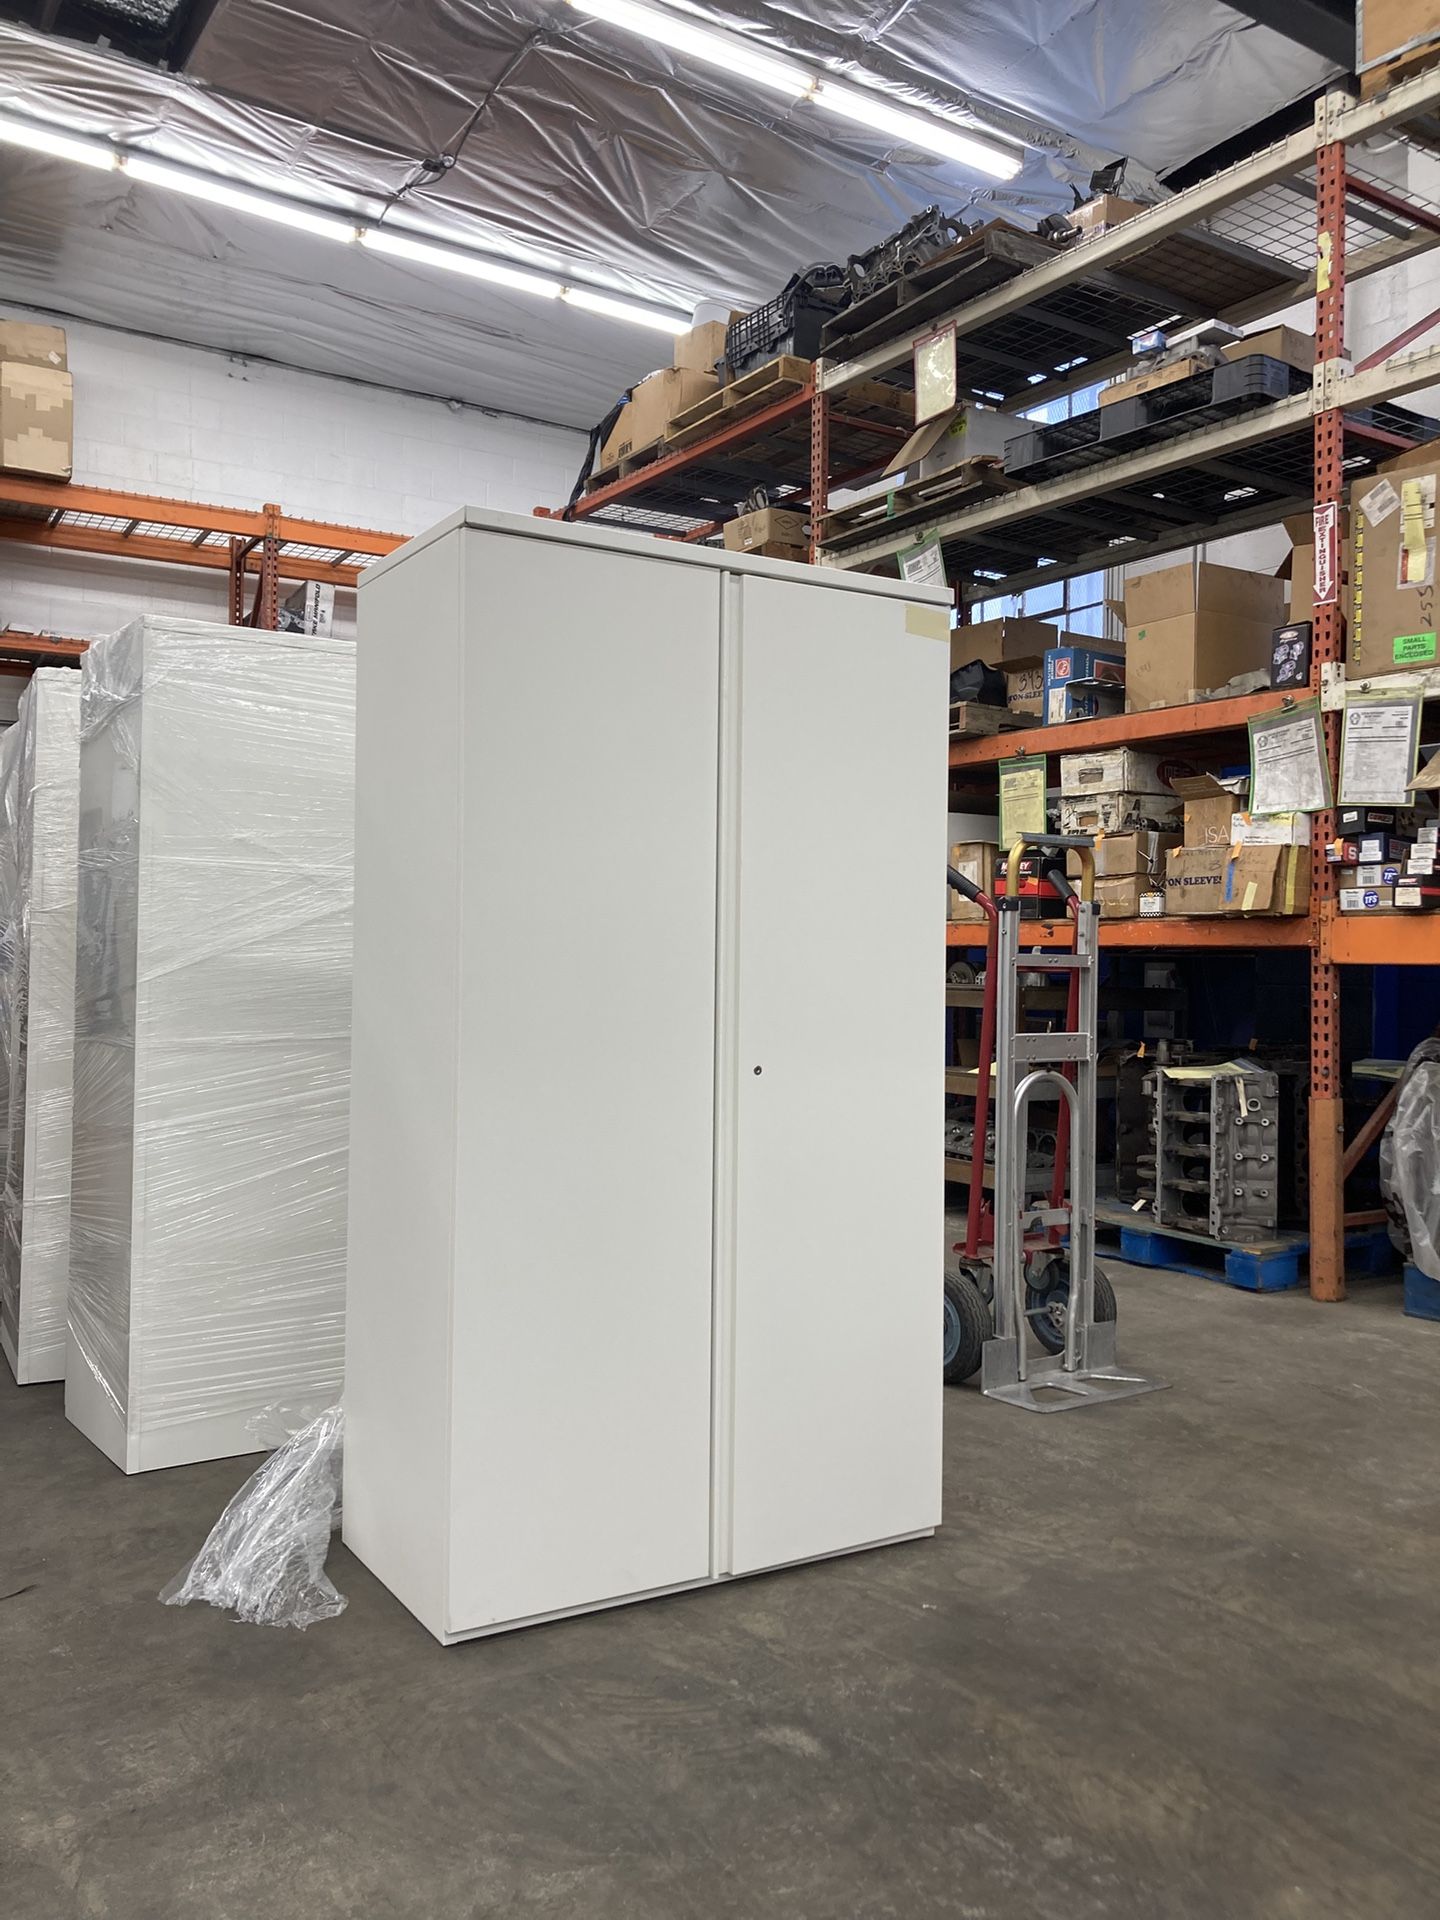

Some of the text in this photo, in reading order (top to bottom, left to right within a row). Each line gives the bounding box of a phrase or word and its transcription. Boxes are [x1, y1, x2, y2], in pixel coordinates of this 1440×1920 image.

[1318, 526, 1327, 594] EXTINGUISHER
[1395, 650, 1434, 660] ENCLOSED
[1383, 872, 1397, 880] TF
[1166, 878, 1181, 886] ON
[1364, 895, 1378, 904] TFS
